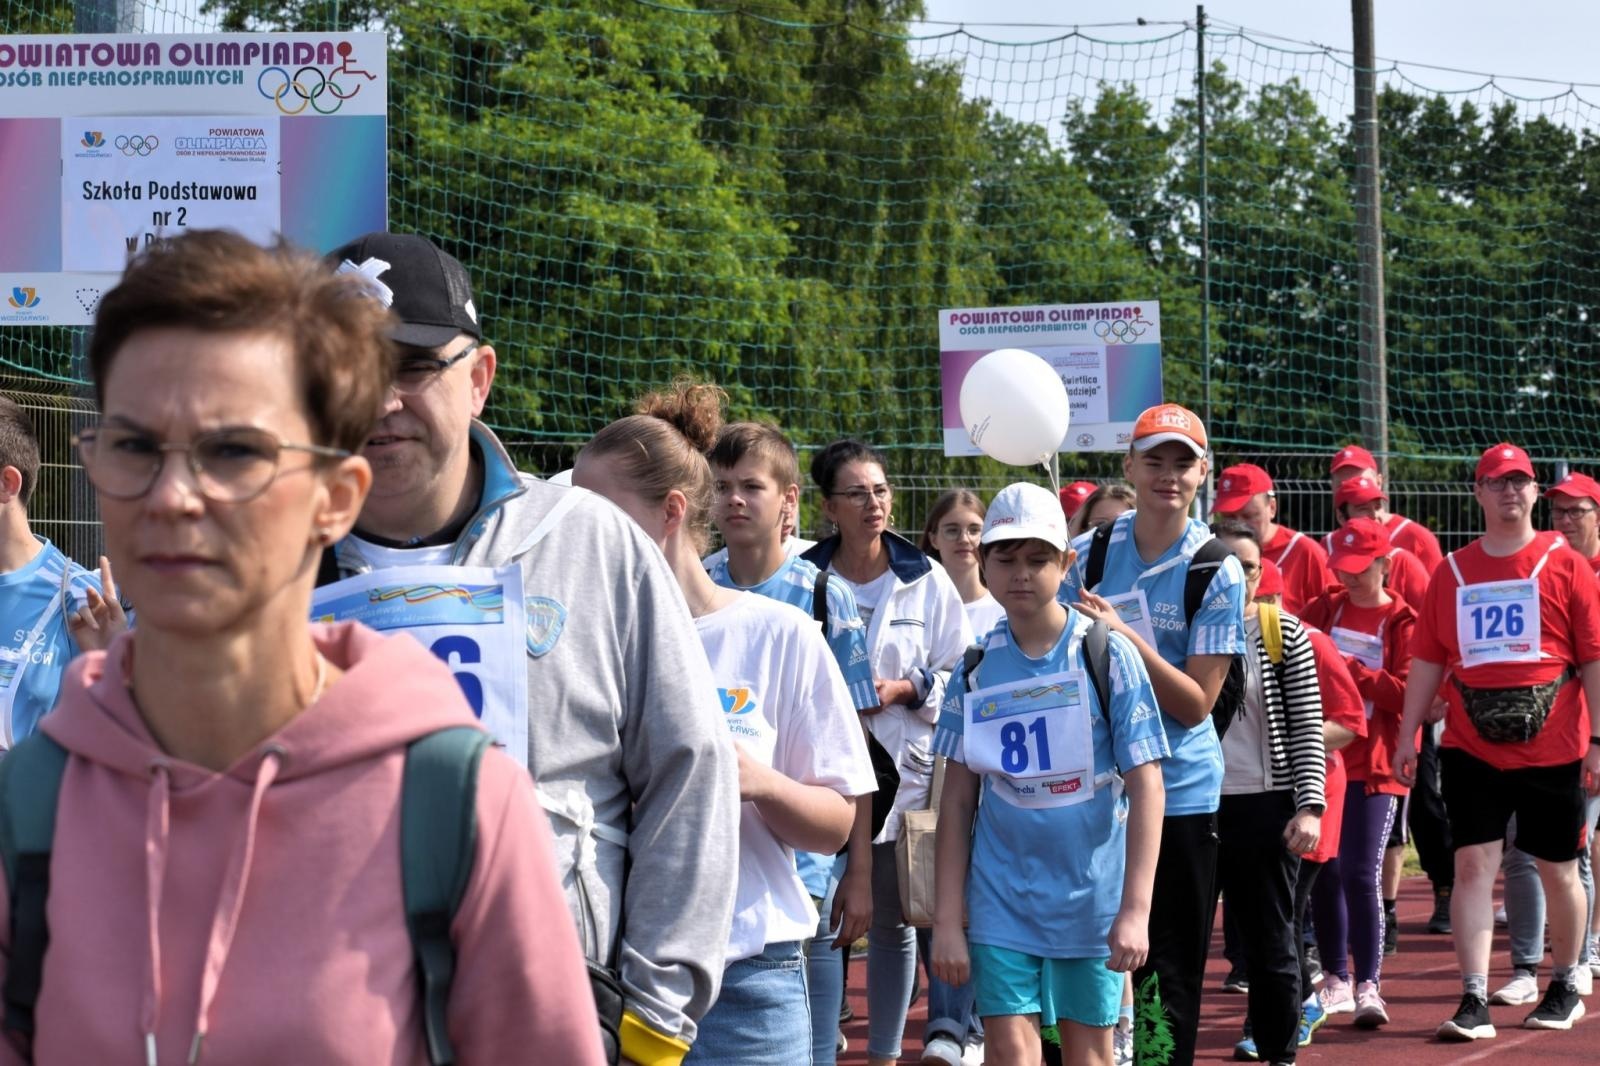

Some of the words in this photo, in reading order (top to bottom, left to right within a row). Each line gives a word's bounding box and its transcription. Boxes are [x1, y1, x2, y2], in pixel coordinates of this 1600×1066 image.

[169, 41, 334, 67] OLIMPIADA
[48, 70, 243, 86] NIEPEŁNOSPRAWNYCH
[209, 128, 265, 137] POWIATOWA
[175, 137, 267, 149] OLIMPIADA
[82, 181, 142, 200] Szkoła
[149, 181, 257, 200] Podstawowa
[152, 211, 172, 226] nr
[177, 207, 187, 226] 2
[950, 310, 1045, 325] POWIATOWA
[1048, 307, 1132, 322] OLIMPIADA
[959, 325, 985, 335] OSÓB
[1154, 602, 1178, 616] SP2
[1151, 617, 1186, 631] SZÓW
[1470, 603, 1524, 640] 126
[1000, 716, 1051, 774] 81
[1052, 782, 1078, 793] EFEKT
